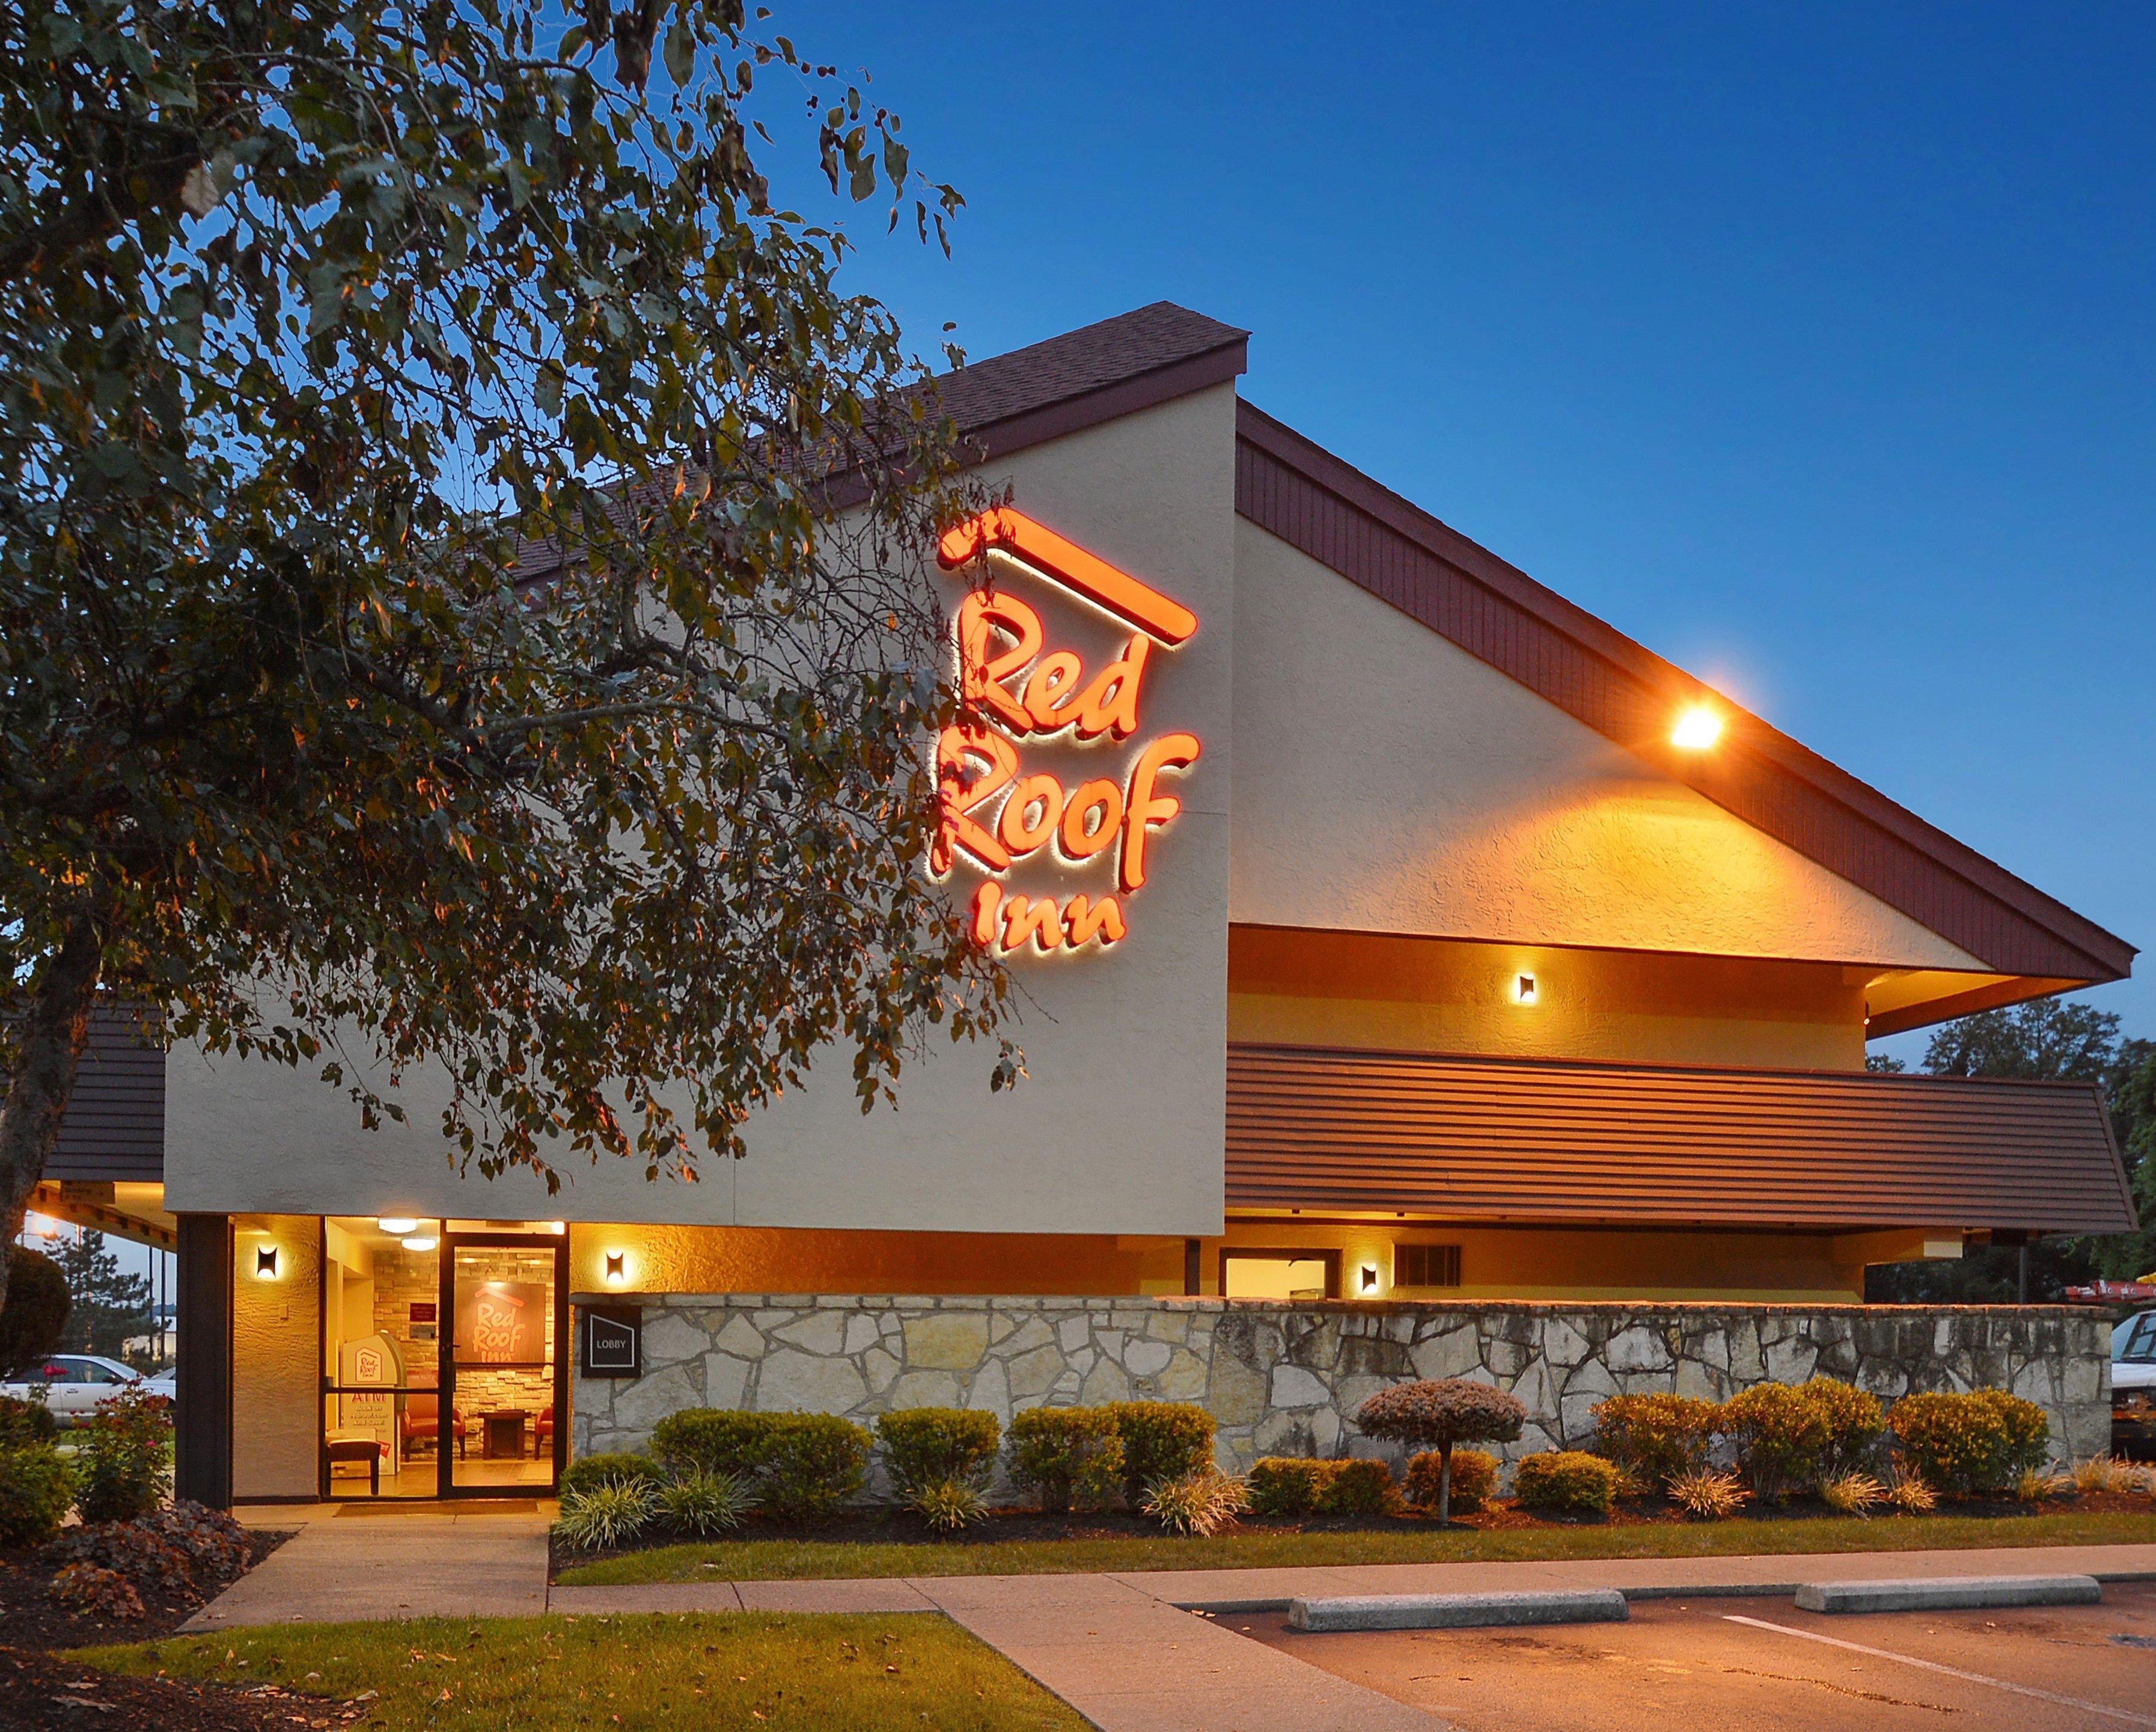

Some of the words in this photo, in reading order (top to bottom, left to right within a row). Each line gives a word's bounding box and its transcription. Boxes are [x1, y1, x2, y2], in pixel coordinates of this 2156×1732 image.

[959, 588, 1150, 739] Red
[930, 725, 1200, 893] Roof
[477, 1303, 516, 1329] Red
[473, 1323, 526, 1353] Roof
[597, 1339, 626, 1348] LOBBY
[360, 1364, 379, 1375] Roof
[361, 1357, 375, 1366] Red
